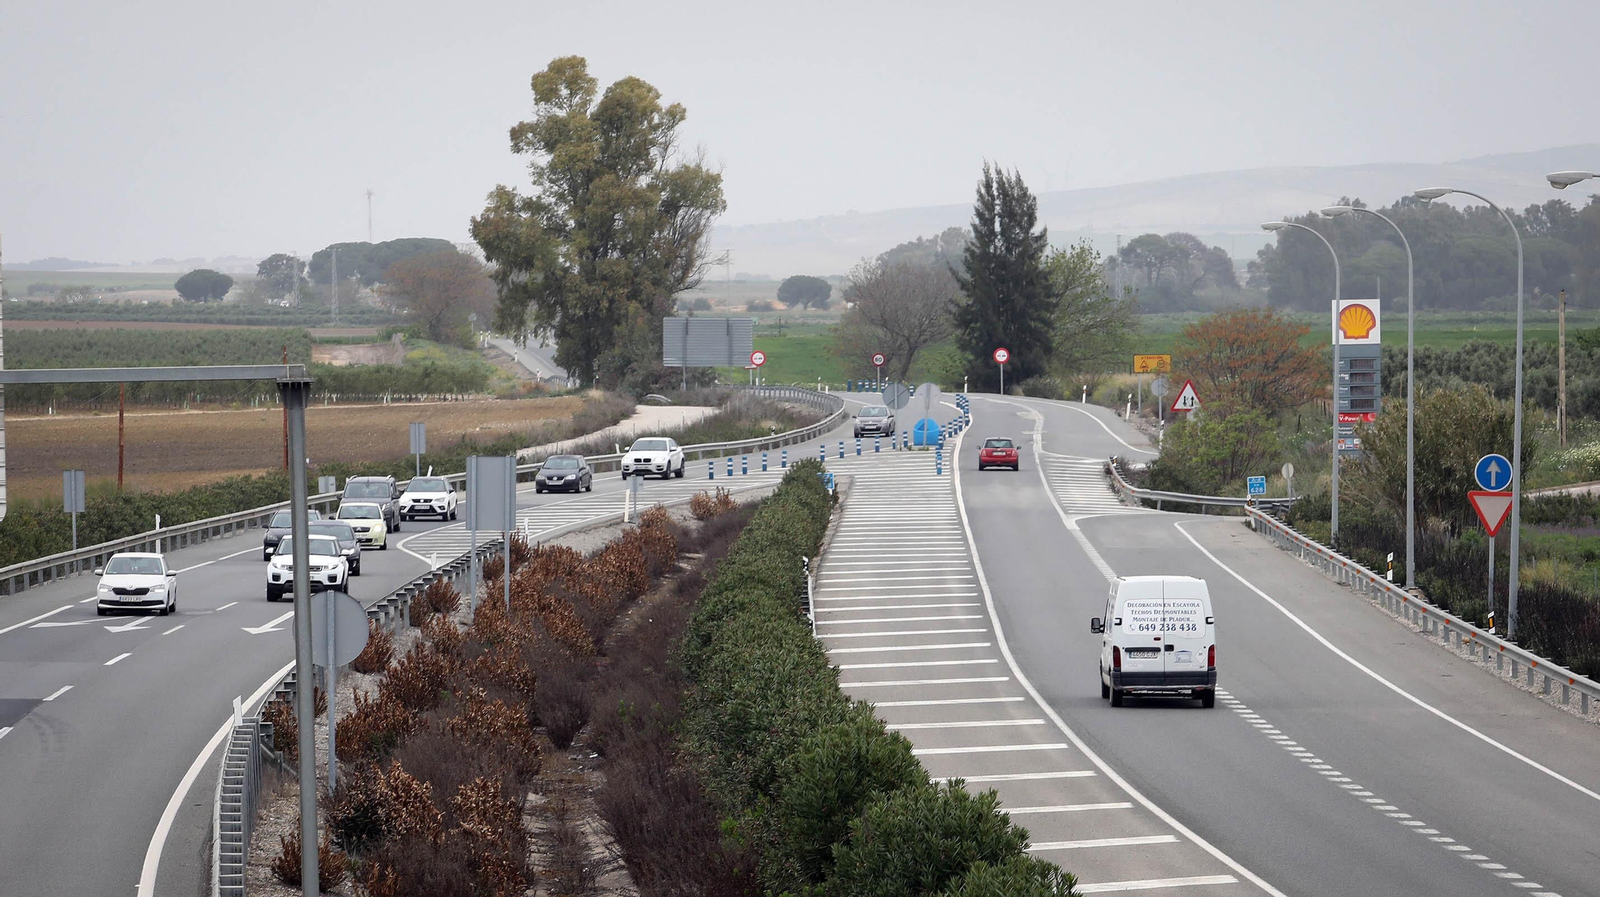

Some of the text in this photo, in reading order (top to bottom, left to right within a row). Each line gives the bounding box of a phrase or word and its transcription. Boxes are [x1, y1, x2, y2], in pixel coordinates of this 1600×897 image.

[1138, 623, 1197, 631] 649 238 438
